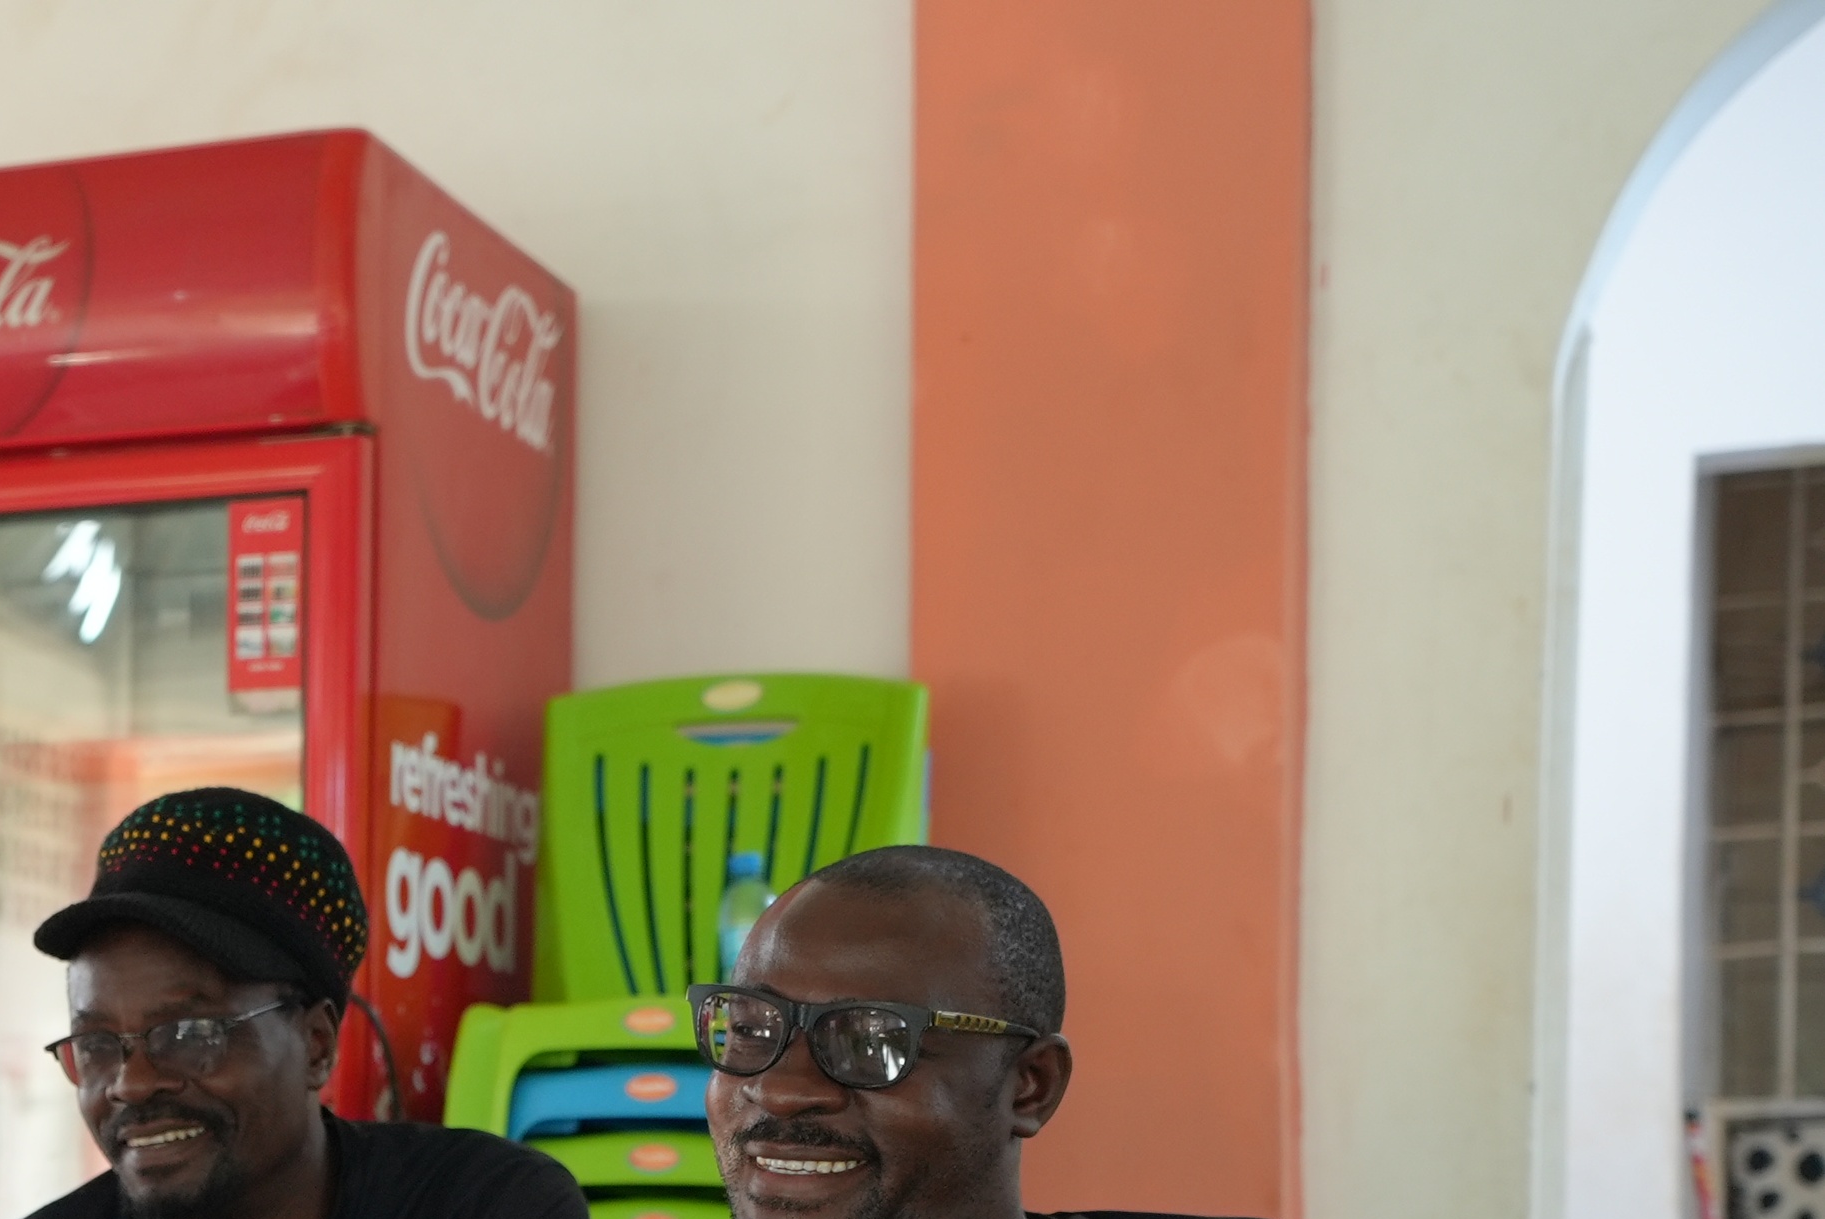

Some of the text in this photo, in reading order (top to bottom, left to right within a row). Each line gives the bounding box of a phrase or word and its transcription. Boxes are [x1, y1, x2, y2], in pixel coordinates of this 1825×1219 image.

[405, 231, 564, 452] Coca-Cola
[389, 732, 539, 865] refreshing
[385, 847, 518, 978] good
